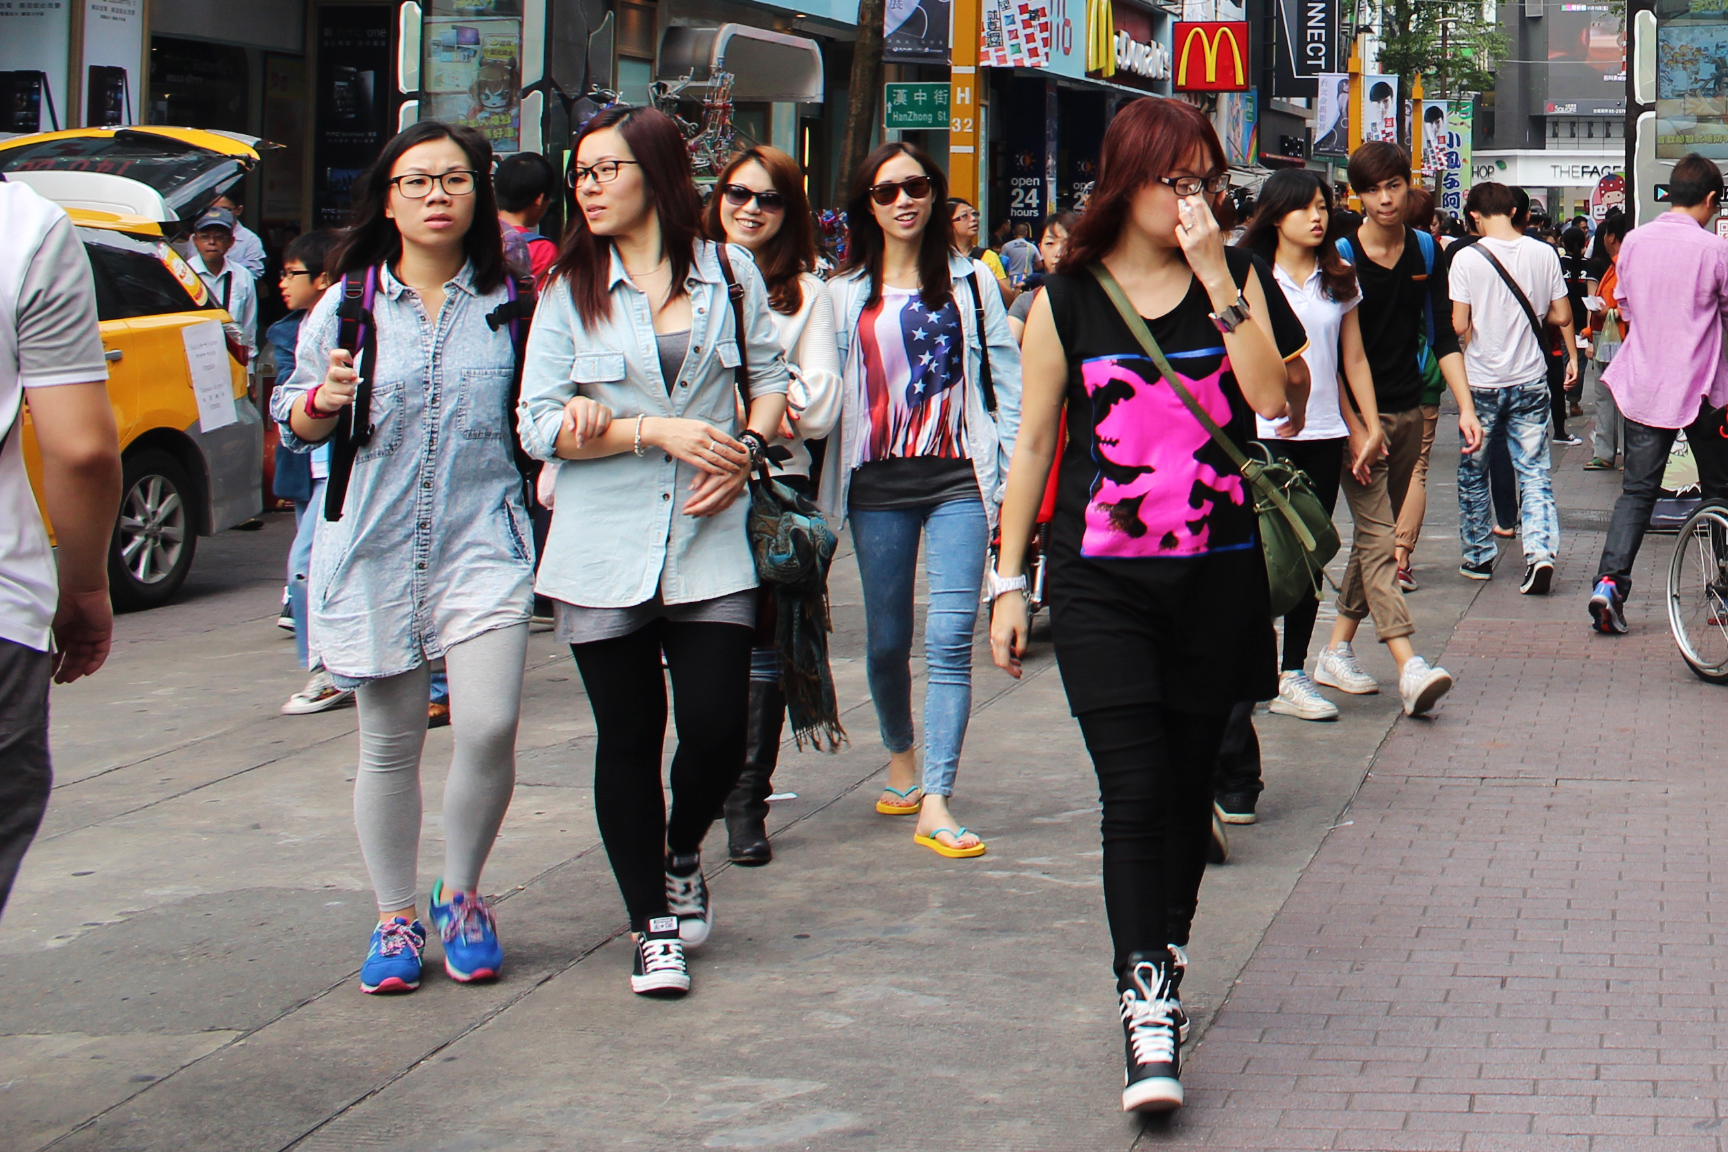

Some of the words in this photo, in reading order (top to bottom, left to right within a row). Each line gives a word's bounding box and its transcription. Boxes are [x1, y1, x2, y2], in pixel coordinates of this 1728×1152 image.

[892, 88, 949, 106] 漢中街
[956, 86, 971, 105] H
[892, 111, 933, 123] HanZhong
[937, 111, 949, 122] St.
[951, 117, 974, 133] 32
[1471, 165, 1495, 178] HOP
[1010, 177, 1040, 189] open
[1010, 189, 1040, 208] 24
[1010, 208, 1040, 218] hours
